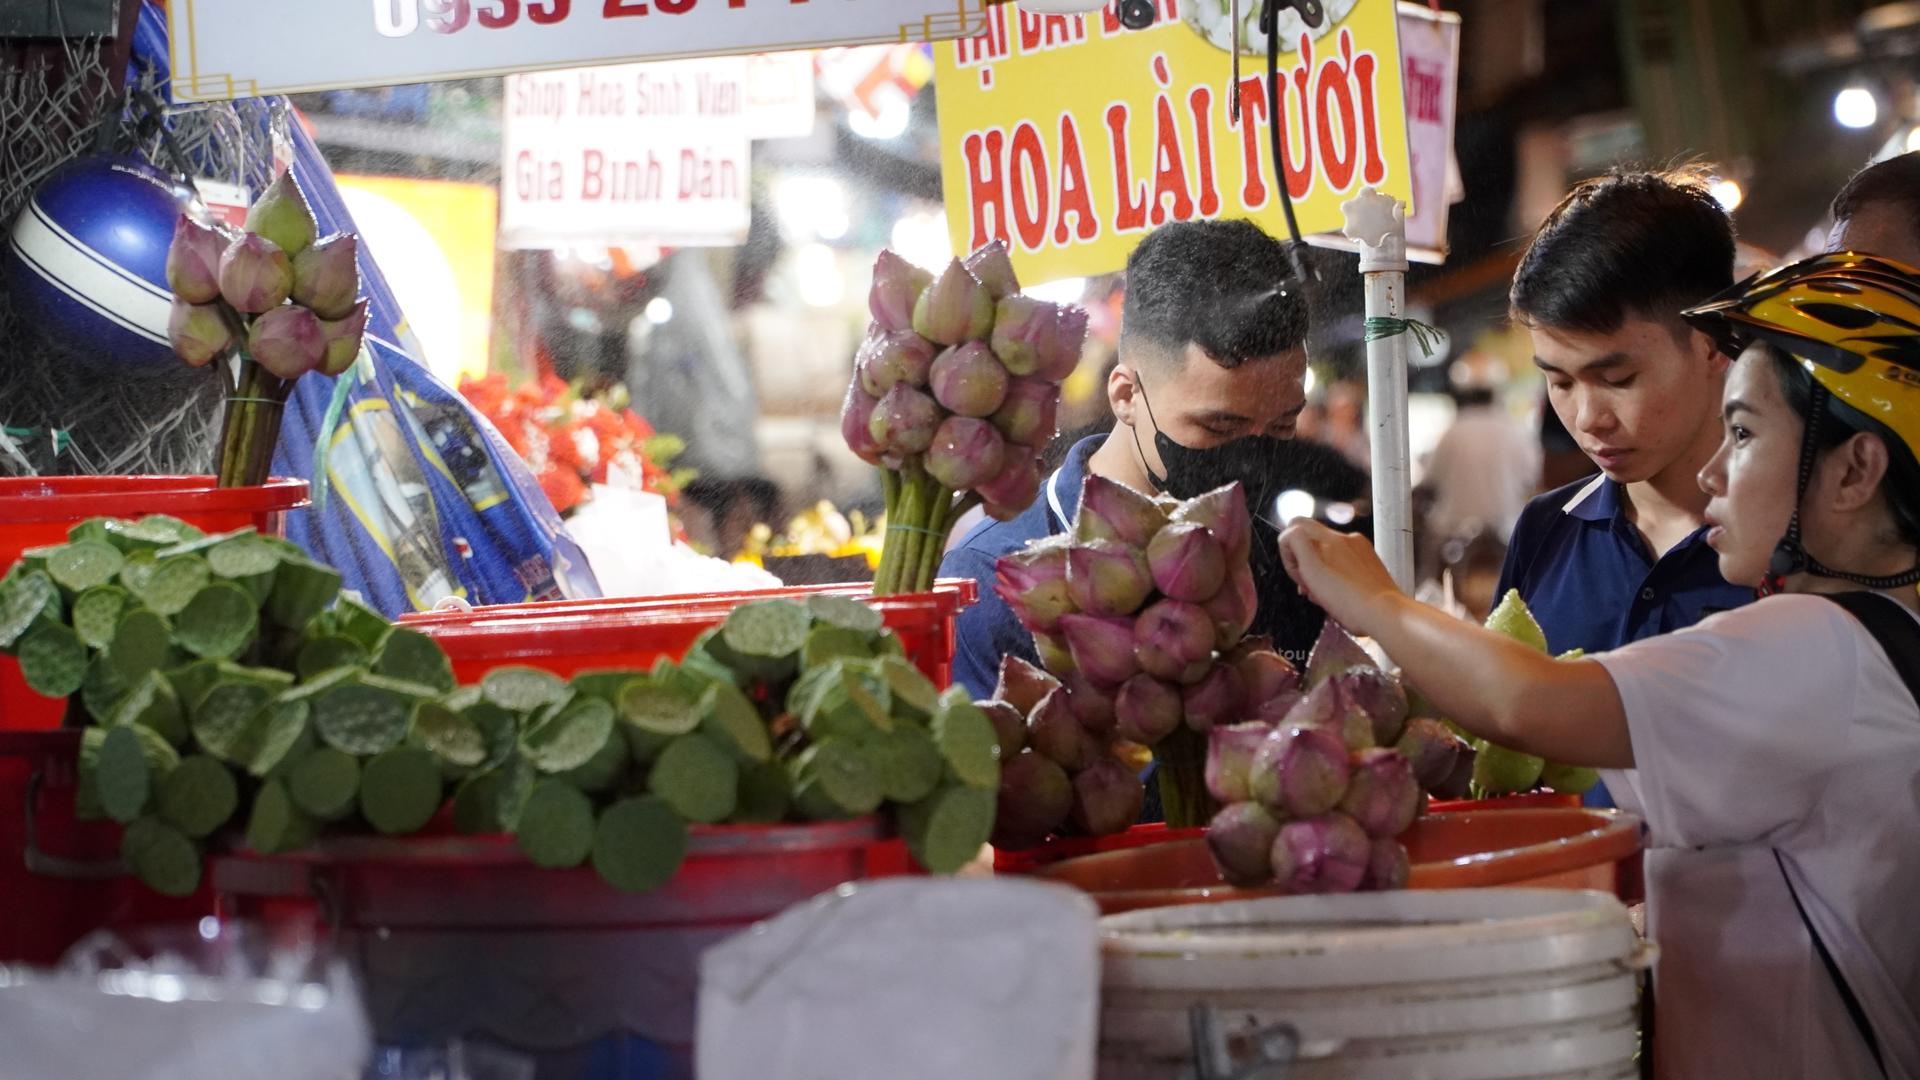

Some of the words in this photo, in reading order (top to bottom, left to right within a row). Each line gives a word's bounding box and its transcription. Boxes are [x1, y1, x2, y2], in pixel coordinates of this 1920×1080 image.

[511, 73, 568, 124] Shop
[576, 71, 626, 117] Hoa
[965, 113, 1097, 252] HOA
[1107, 55, 1219, 231] LÀI
[1229, 29, 1384, 208] TƯƠI
